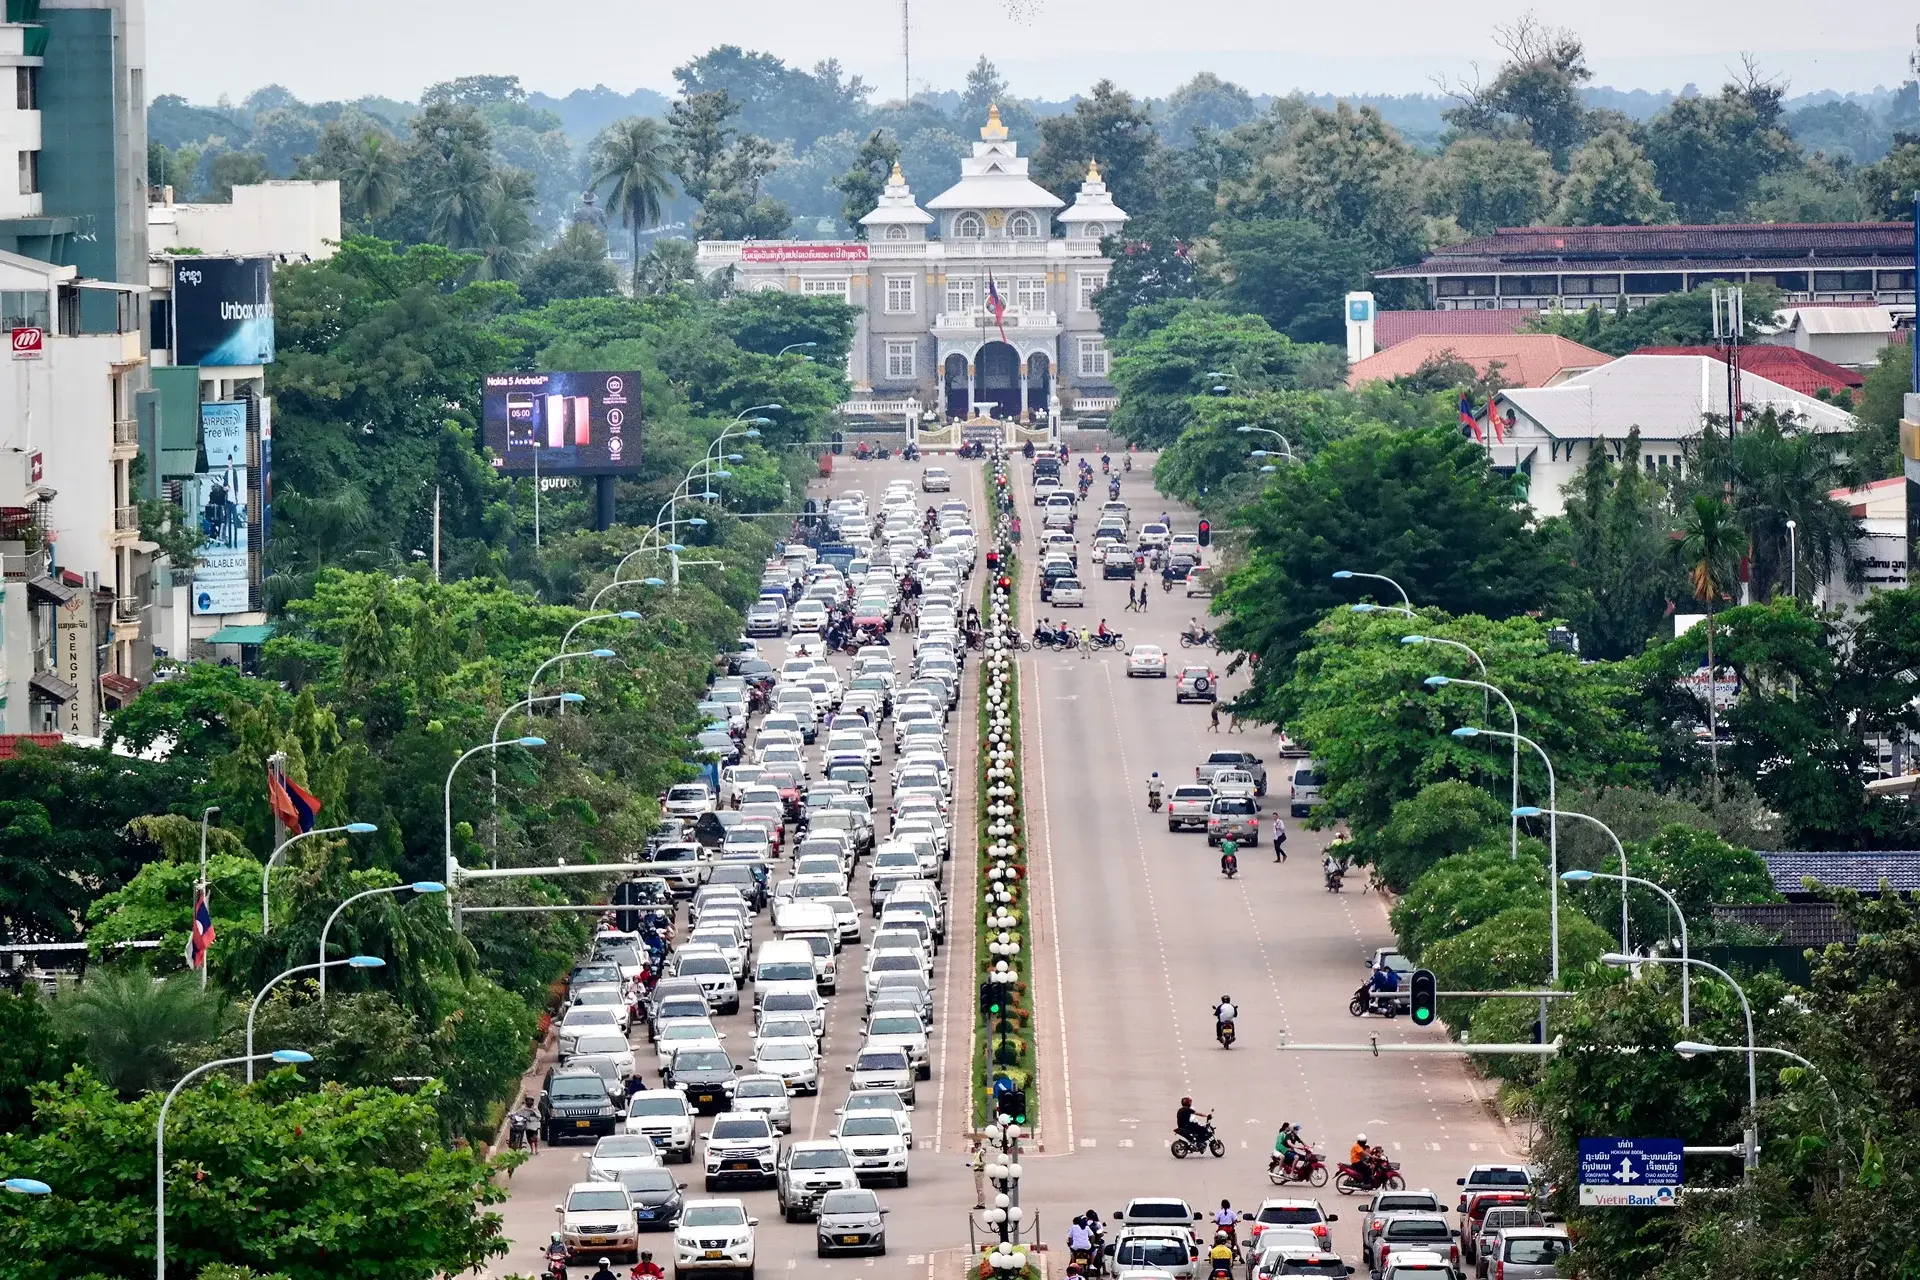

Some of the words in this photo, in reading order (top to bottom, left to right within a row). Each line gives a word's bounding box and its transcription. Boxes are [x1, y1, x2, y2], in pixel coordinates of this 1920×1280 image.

[221, 301, 254, 320] Unbox
[487, 377, 508, 386] Nokia
[509, 377, 514, 385] 5
[203, 416, 233, 426] AIRPORT
[204, 427, 222, 438] Free
[223, 426, 240, 437] Wi-Fi
[1595, 1194, 1657, 1205] VietinBank
